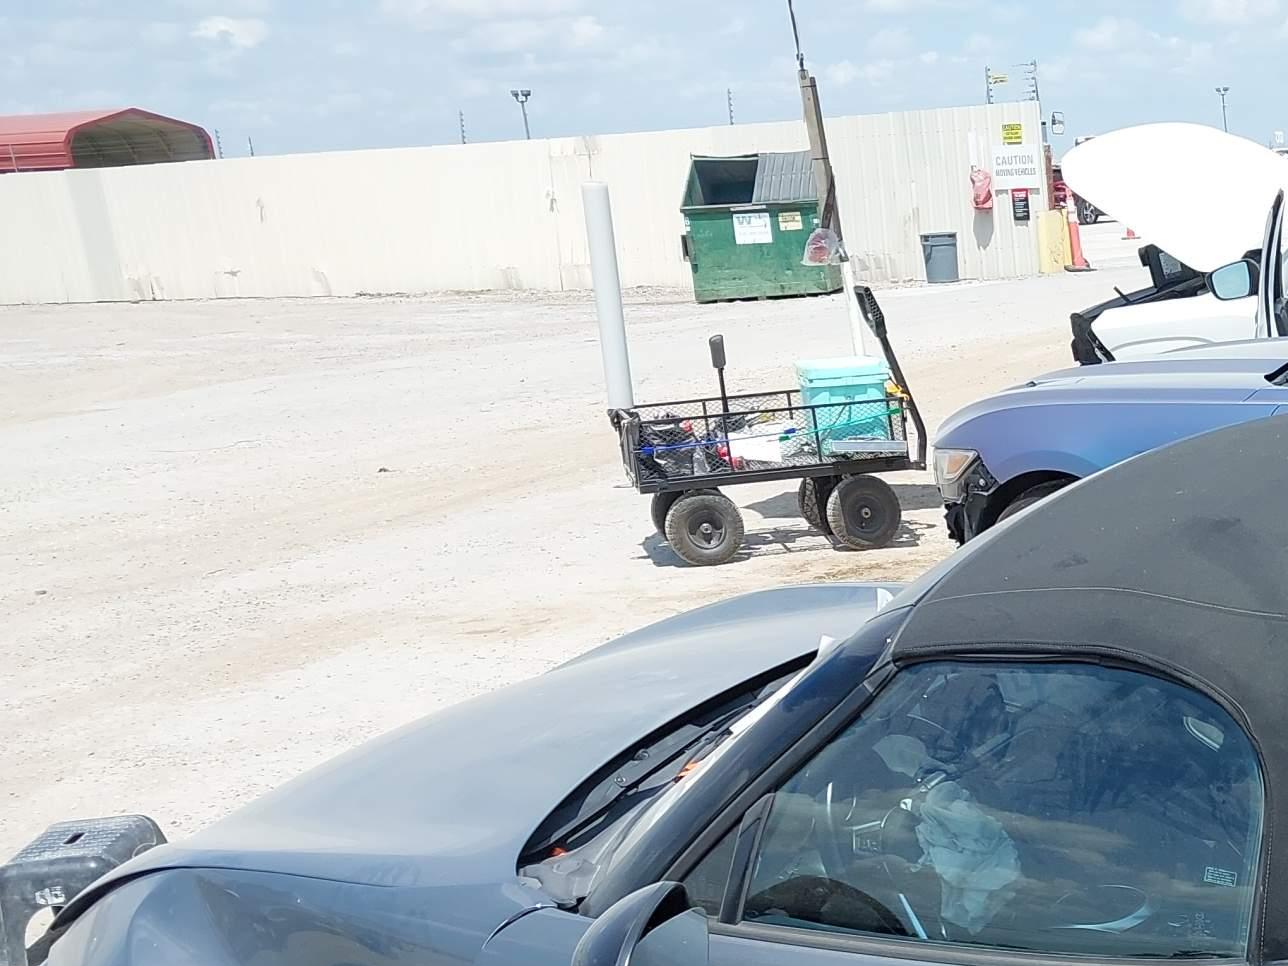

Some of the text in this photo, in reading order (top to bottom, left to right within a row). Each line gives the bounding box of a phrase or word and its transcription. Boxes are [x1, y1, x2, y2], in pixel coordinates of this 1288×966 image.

[995, 154, 1034, 167] CAUTION
[995, 167, 1037, 177] MOVING VEHICLES
